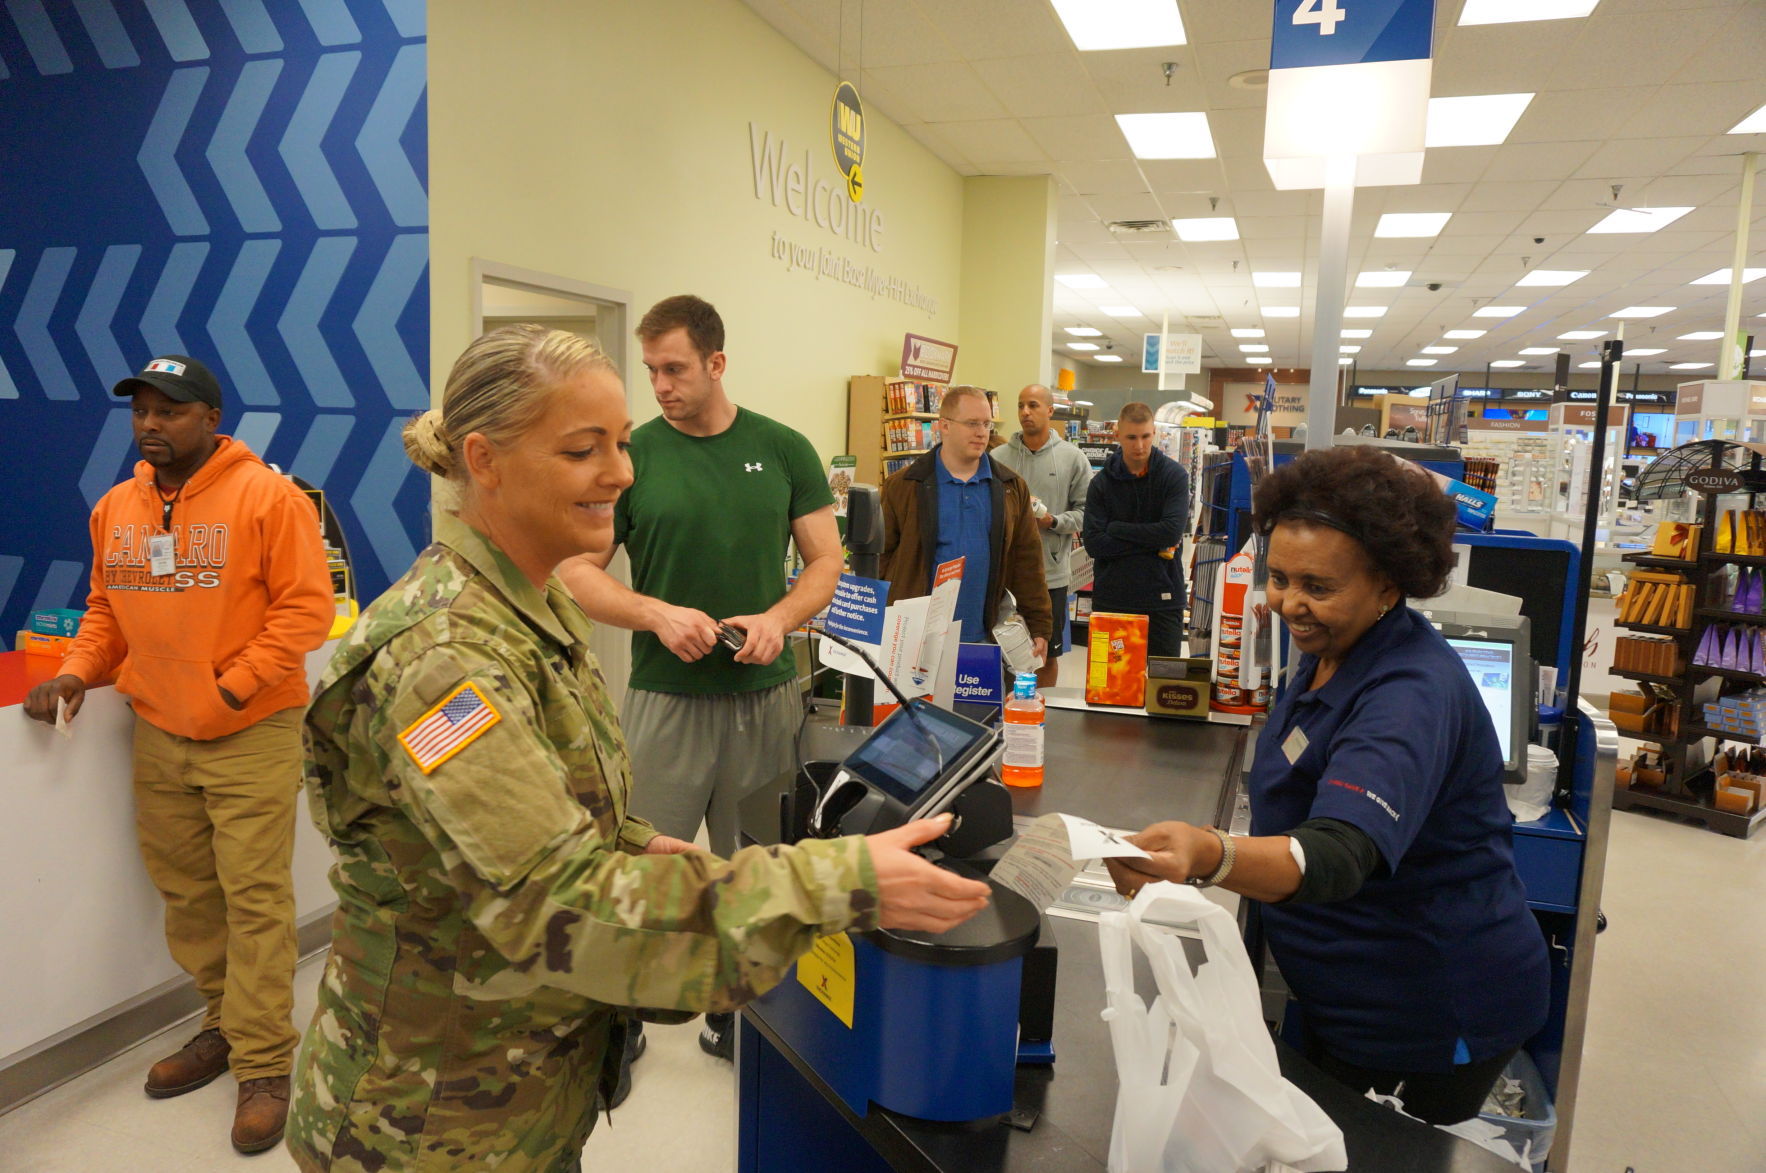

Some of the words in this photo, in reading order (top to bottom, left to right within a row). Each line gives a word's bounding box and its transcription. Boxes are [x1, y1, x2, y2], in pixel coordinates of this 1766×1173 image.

[1292, 0, 1346, 35] 4
[748, 120, 884, 253] Welcome
[771, 230, 786, 261] to
[787, 241, 816, 273] your
[1570, 391, 1598, 399] Canon
[1271, 404, 1305, 412] OTHING
[1689, 475, 1739, 486] GODIVA
[1455, 493, 1485, 508] HALLS
[175, 571, 220, 588] SS
[140, 585, 176, 593] MUSCLE
[850, 584, 875, 595] upgrades,
[850, 592, 863, 602] offer
[864, 596, 877, 604] cash
[850, 601, 878, 615] purchases
[958, 673, 980, 685] Use
